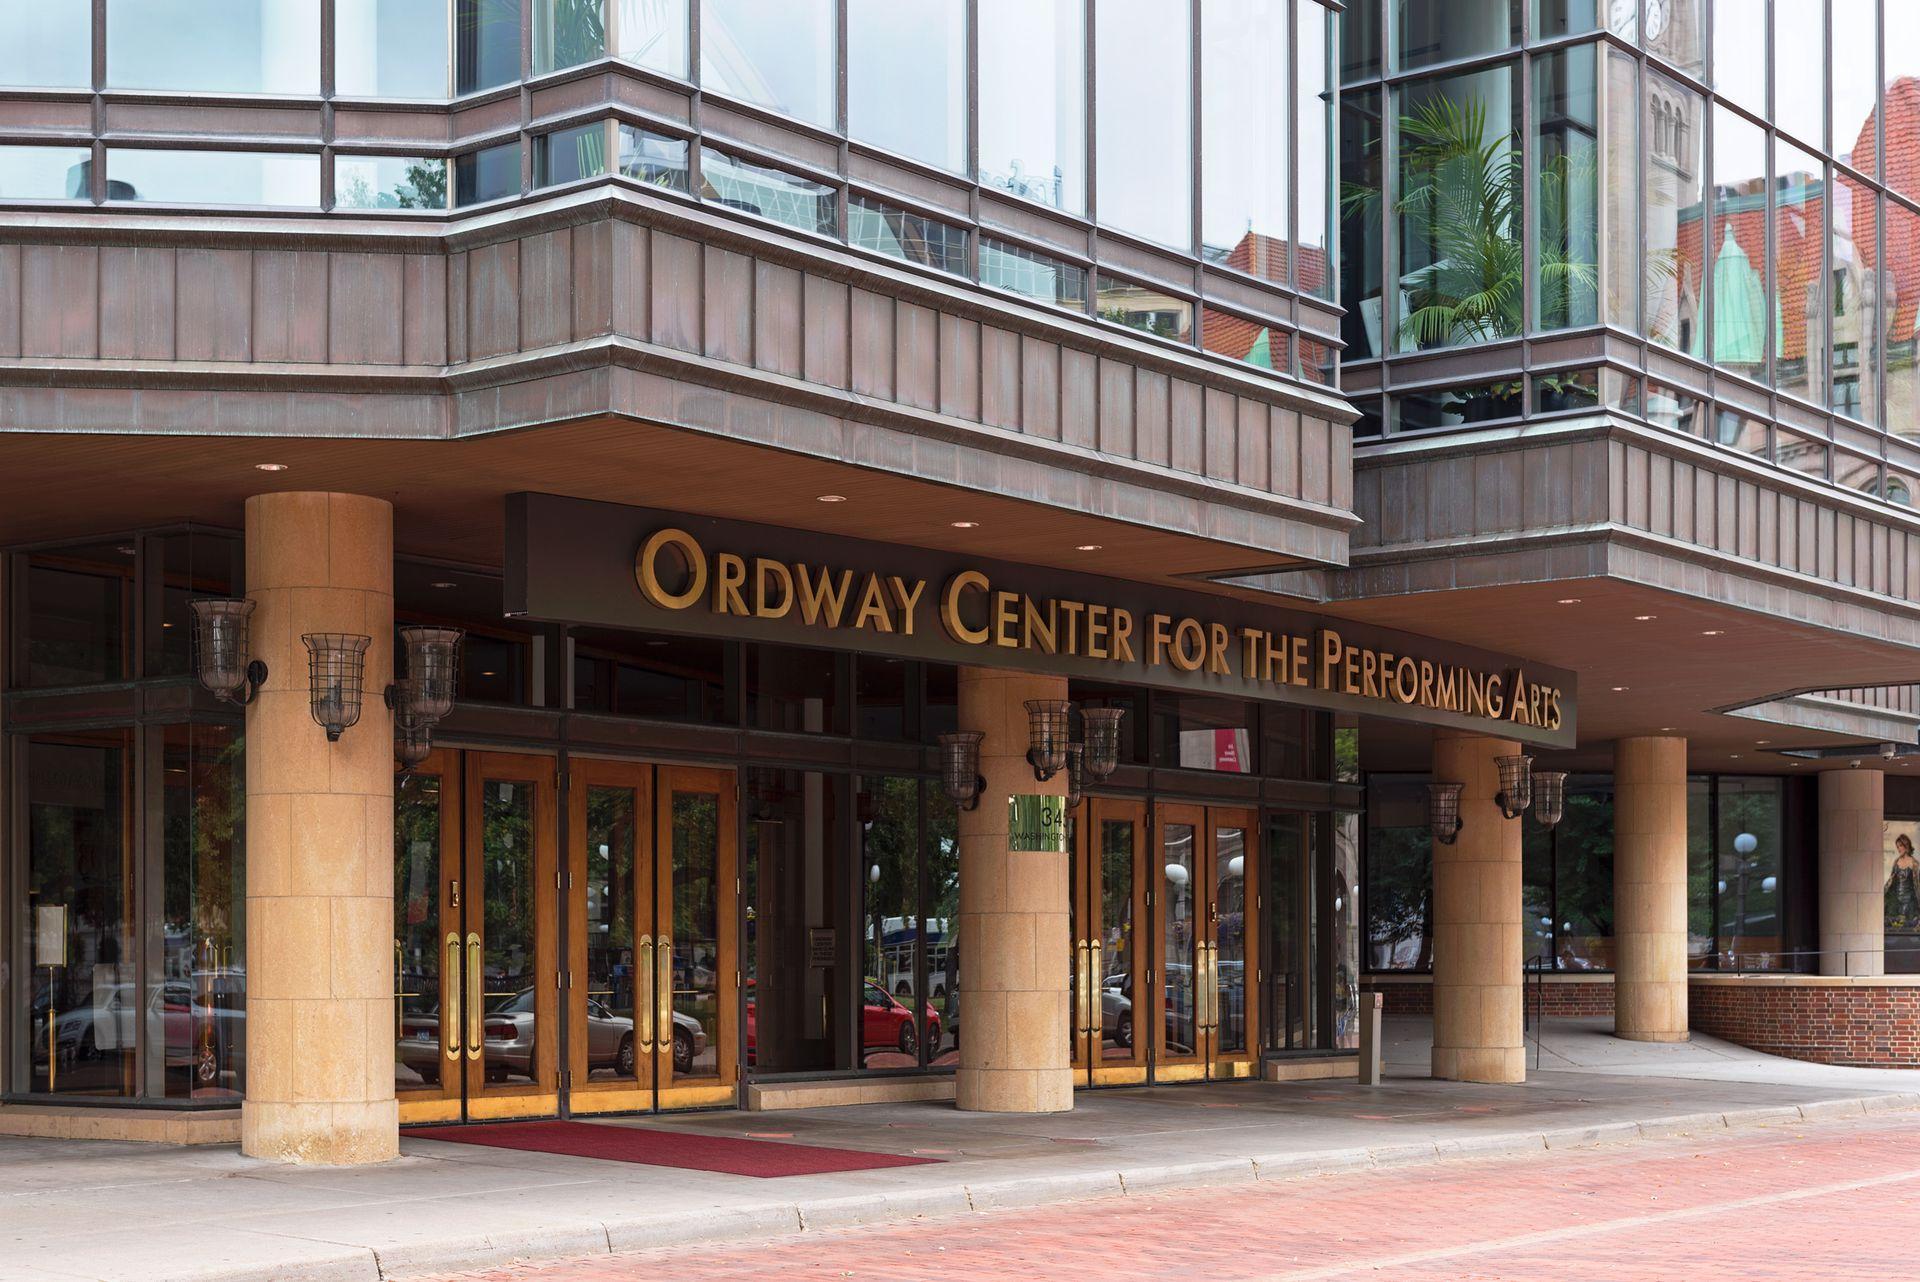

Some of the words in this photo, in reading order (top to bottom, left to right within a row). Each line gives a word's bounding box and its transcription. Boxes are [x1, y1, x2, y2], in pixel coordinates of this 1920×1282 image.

[635, 528, 926, 635] ORDWAY
[940, 570, 1135, 662] CENTER
[1145, 613, 1231, 674] FOR
[1238, 628, 1308, 687] THE
[1315, 629, 1503, 718] PERFORMING
[1510, 668, 1561, 731] ARTS
[1014, 832, 1067, 841] WASHINGTO
